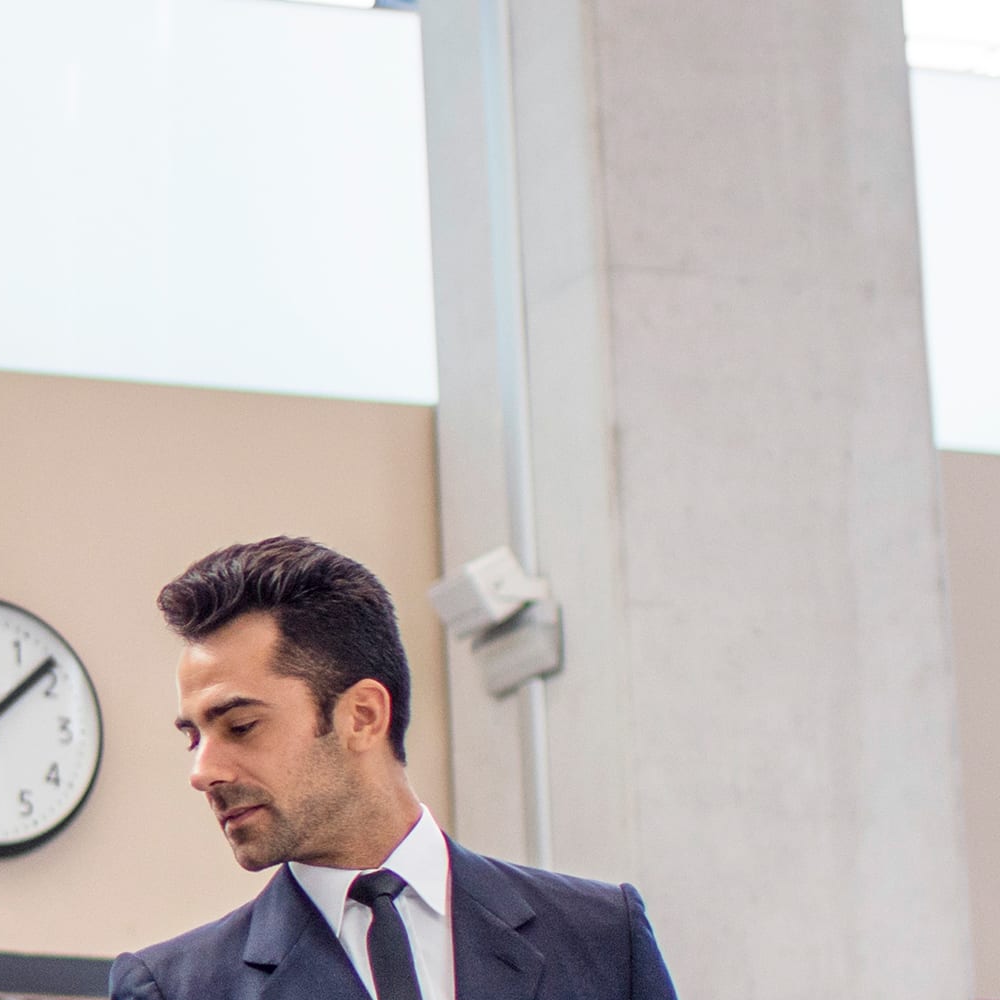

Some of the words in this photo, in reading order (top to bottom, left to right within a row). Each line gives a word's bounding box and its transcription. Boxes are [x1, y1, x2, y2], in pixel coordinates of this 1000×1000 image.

[13, 639, 22, 664] 1
[44, 666, 57, 698] 2
[59, 717, 73, 744] 3
[46, 762, 60, 787] 4
[20, 789, 34, 817] 5
